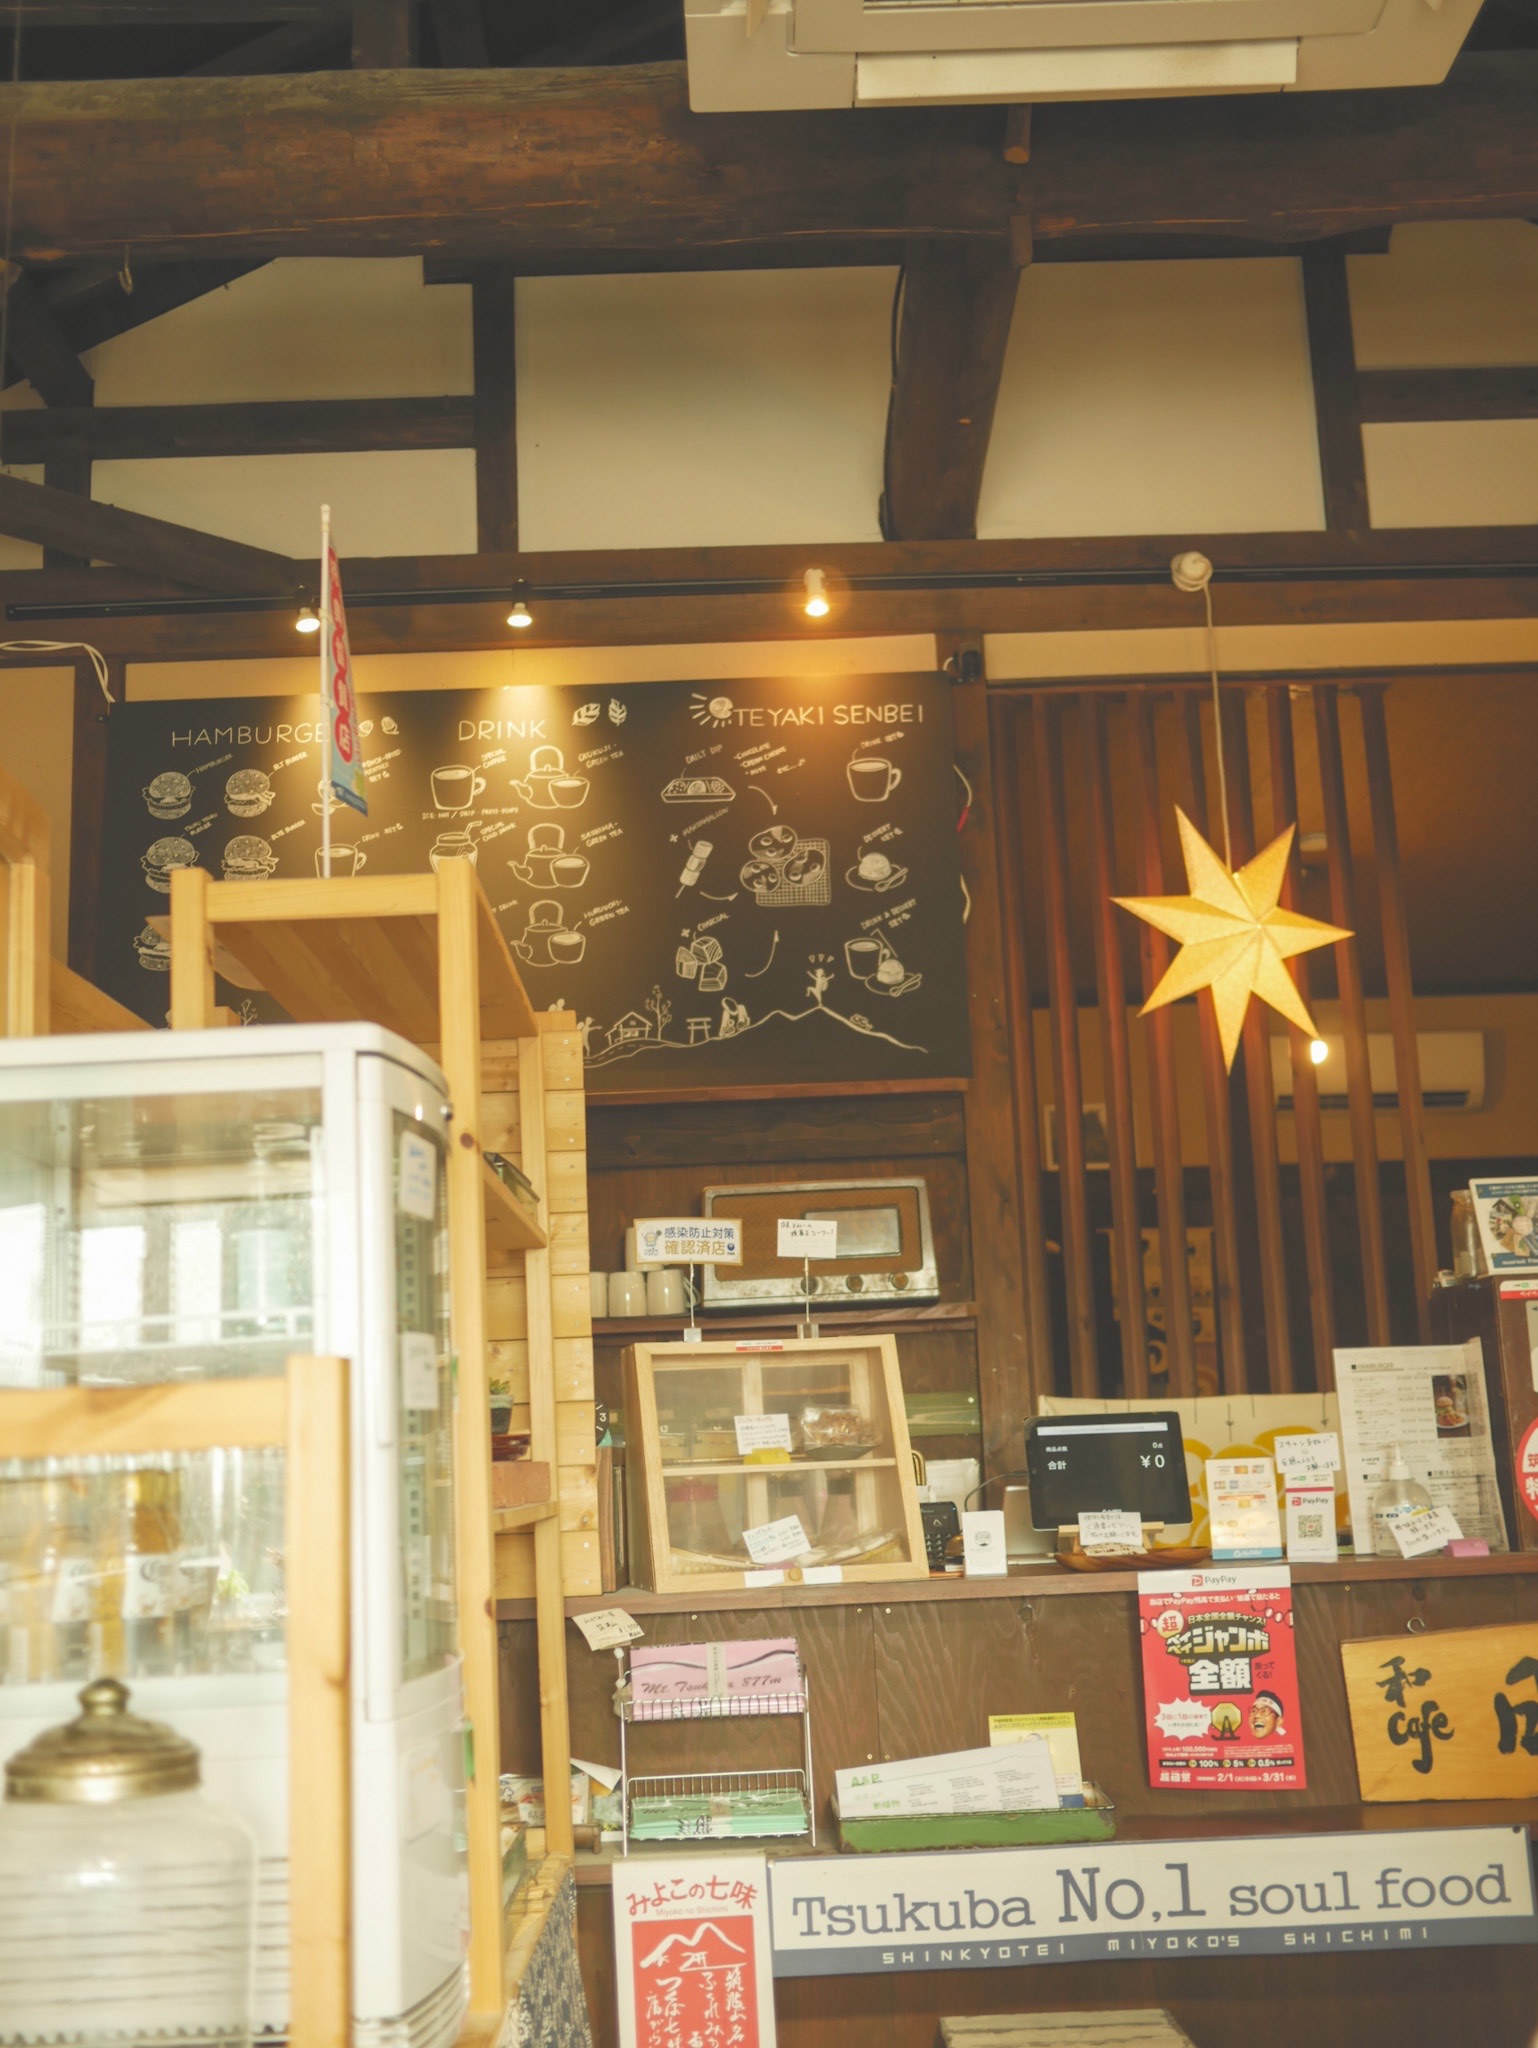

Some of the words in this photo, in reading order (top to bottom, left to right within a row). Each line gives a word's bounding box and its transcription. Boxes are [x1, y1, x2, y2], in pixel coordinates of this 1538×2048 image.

[733, 706, 824, 727] TEYAKI
[833, 704, 923, 725] SENBEI
[459, 720, 546, 741] DRINK
[610, 750, 624, 760] TEA
[609, 828, 623, 838] TEA
[616, 906, 630, 916] TEA
[664, 1227, 735, 1239] 感染防止対策
[665, 1240, 725, 1255] 確認済店
[1047, 1460, 1067, 1470] 合計
[1205, 1576, 1237, 1586] PayPay
[1162, 1615, 1179, 1632] 超
[1189, 1658, 1251, 1689] 全額
[642, 1682, 670, 1694] Mt.
[676, 1680, 734, 1692] Tsuka
[742, 1675, 782, 1687] 877m
[1376, 1656, 1432, 1708] 和
[1258, 1759, 1275, 1767] 0.5%
[1217, 1774, 1234, 1782] 2/1
[1263, 1773, 1285, 1782] 3/31
[626, 1875, 758, 1916] みよこの七味
[793, 1890, 1036, 1937] Tsukuba
[1229, 1871, 1360, 1917] soul
[1375, 1863, 1512, 1909] food
[656, 1908, 683, 1917] Miyoko
[697, 1905, 728, 1914] Shichimi
[883, 1943, 1065, 1965] SHINKYOTEI
[1108, 1935, 1240, 1951] MIYOKO'S
[1284, 1927, 1428, 1945] SHICHIMI
